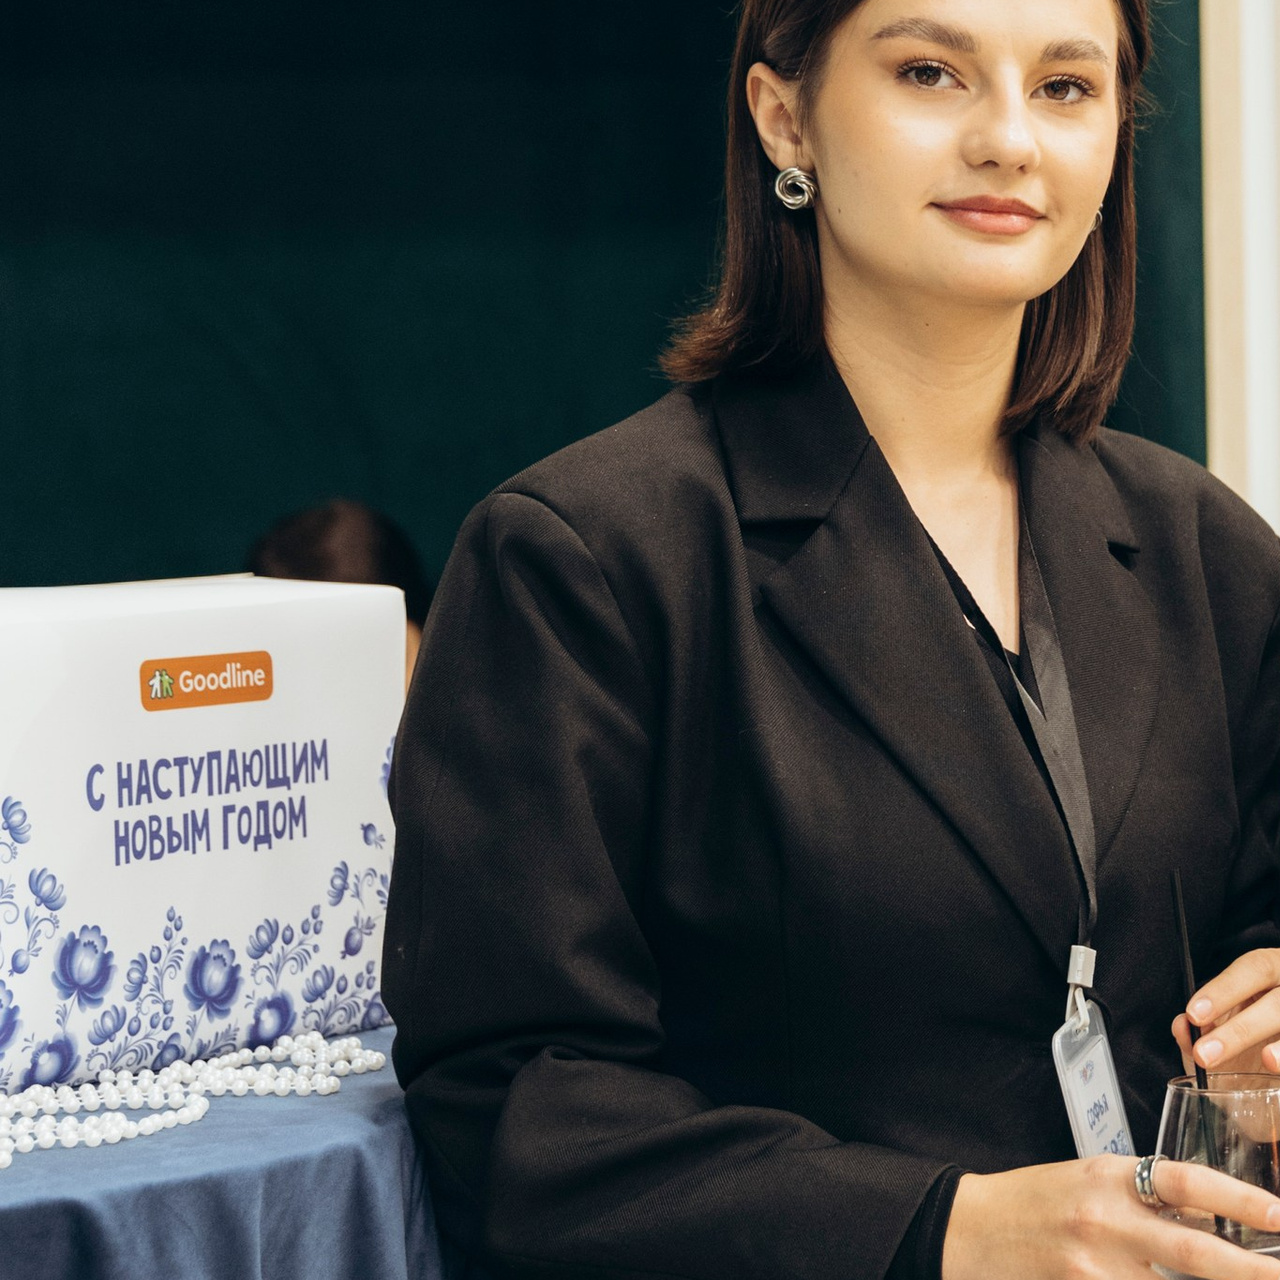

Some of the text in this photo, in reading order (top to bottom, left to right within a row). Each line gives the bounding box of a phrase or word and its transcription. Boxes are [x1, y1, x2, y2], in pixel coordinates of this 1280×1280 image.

[179, 662, 266, 693] Goodline
[86, 738, 329, 812] С НАСТУПАЮЩИМ
[113, 795, 308, 866] НОВЫМ ГОДОМ
